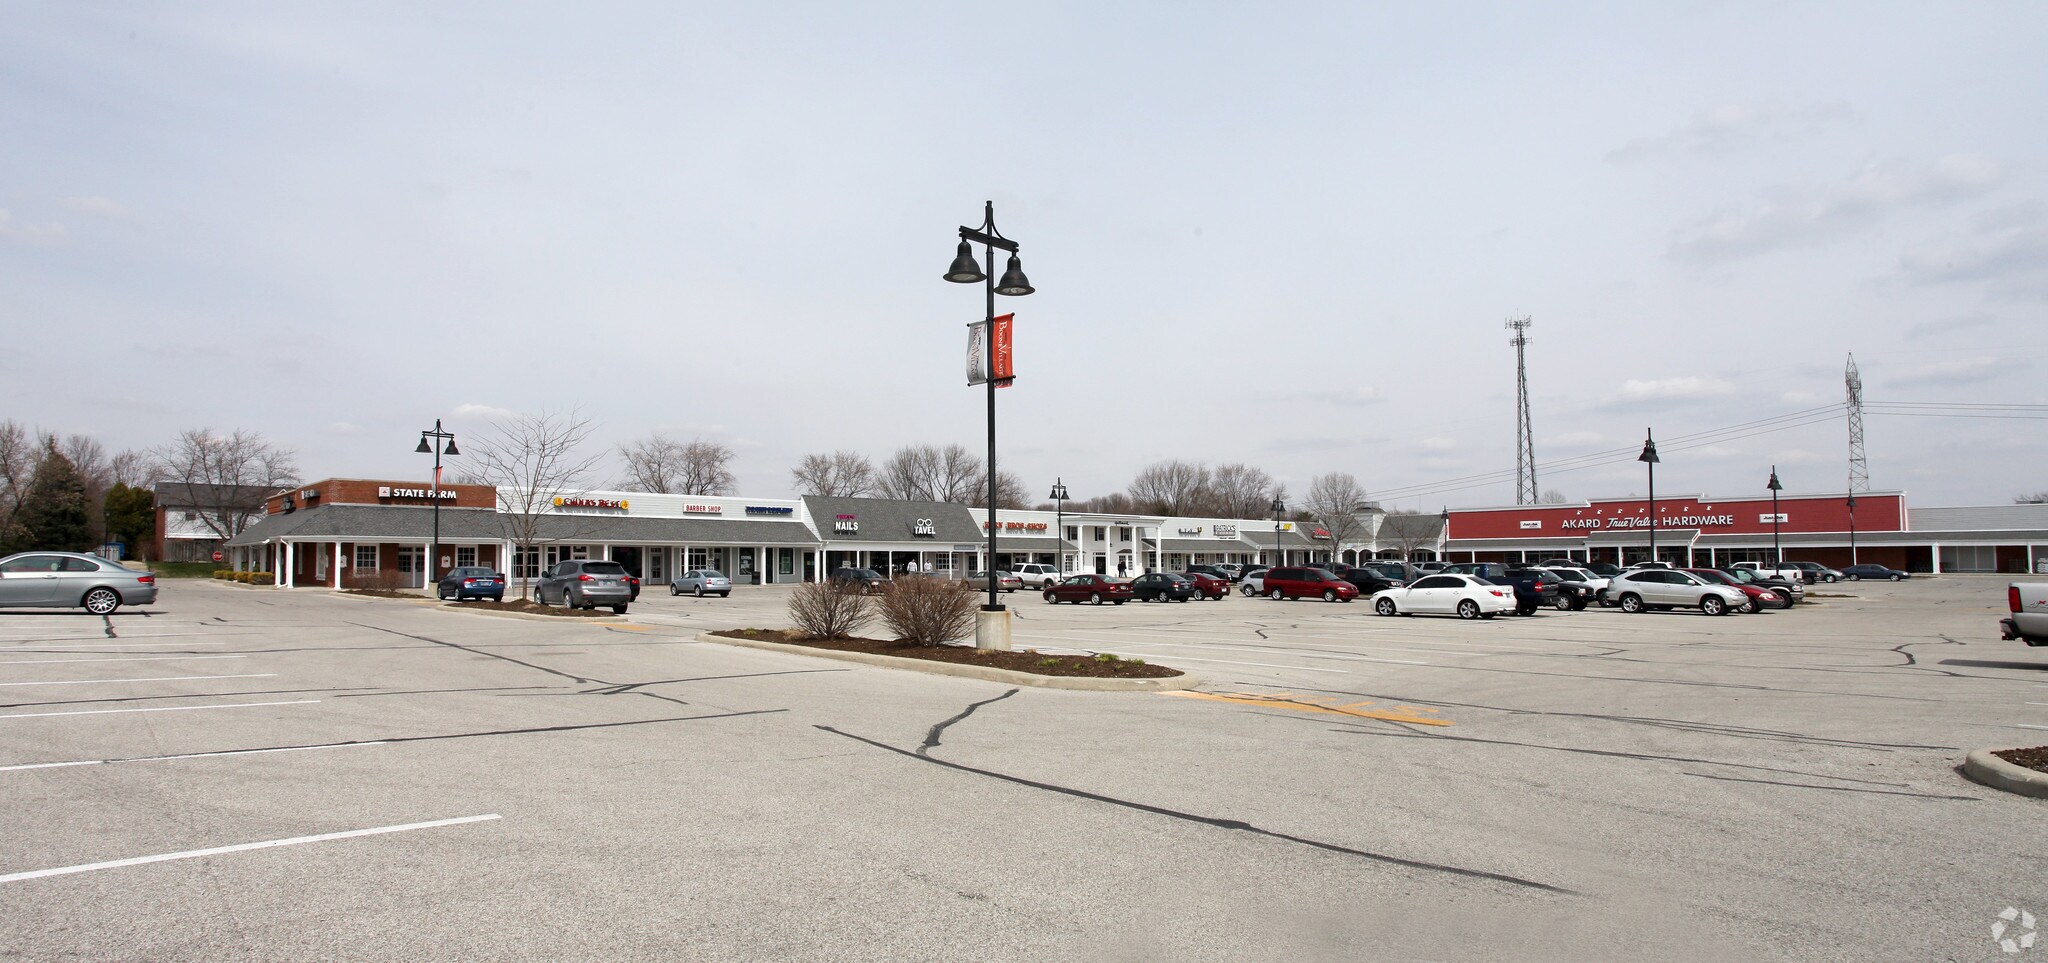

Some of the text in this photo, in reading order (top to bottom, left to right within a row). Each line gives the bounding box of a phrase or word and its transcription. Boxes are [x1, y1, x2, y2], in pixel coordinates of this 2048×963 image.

[394, 488, 424, 498] STATE
[836, 522, 858, 530] NAILS
[1562, 520, 1600, 528] AKARD
[1662, 515, 1733, 526] HARDWARE
[914, 526, 936, 534] TAVEL
